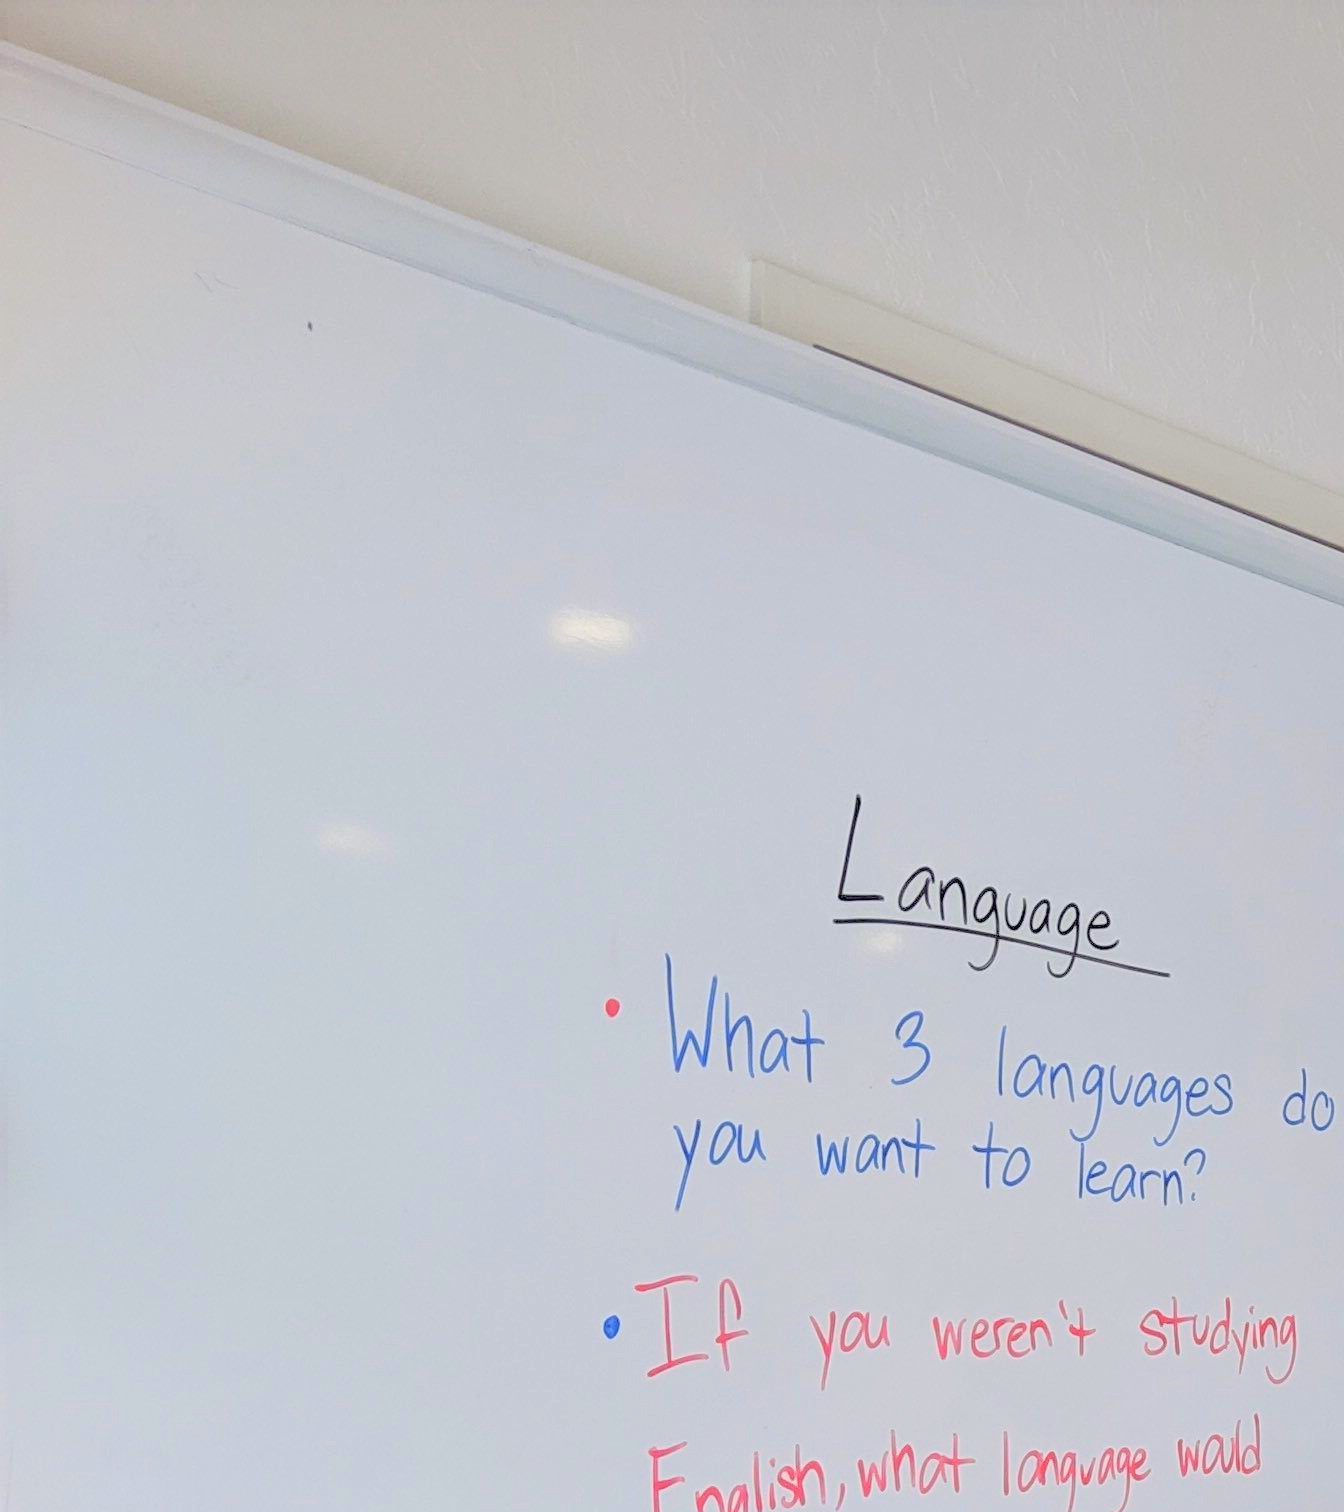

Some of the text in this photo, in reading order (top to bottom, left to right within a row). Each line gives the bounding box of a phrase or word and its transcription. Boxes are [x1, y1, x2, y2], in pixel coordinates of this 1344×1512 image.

[837, 794, 1120, 977] Language
[666, 953, 1336, 1146] What 3 languages do
[674, 1118, 1207, 1212] you want to learn?
[634, 1274, 1298, 1391] If you weren't studying
[857, 1429, 976, 1499] what
[1175, 1412, 1263, 1478] would
